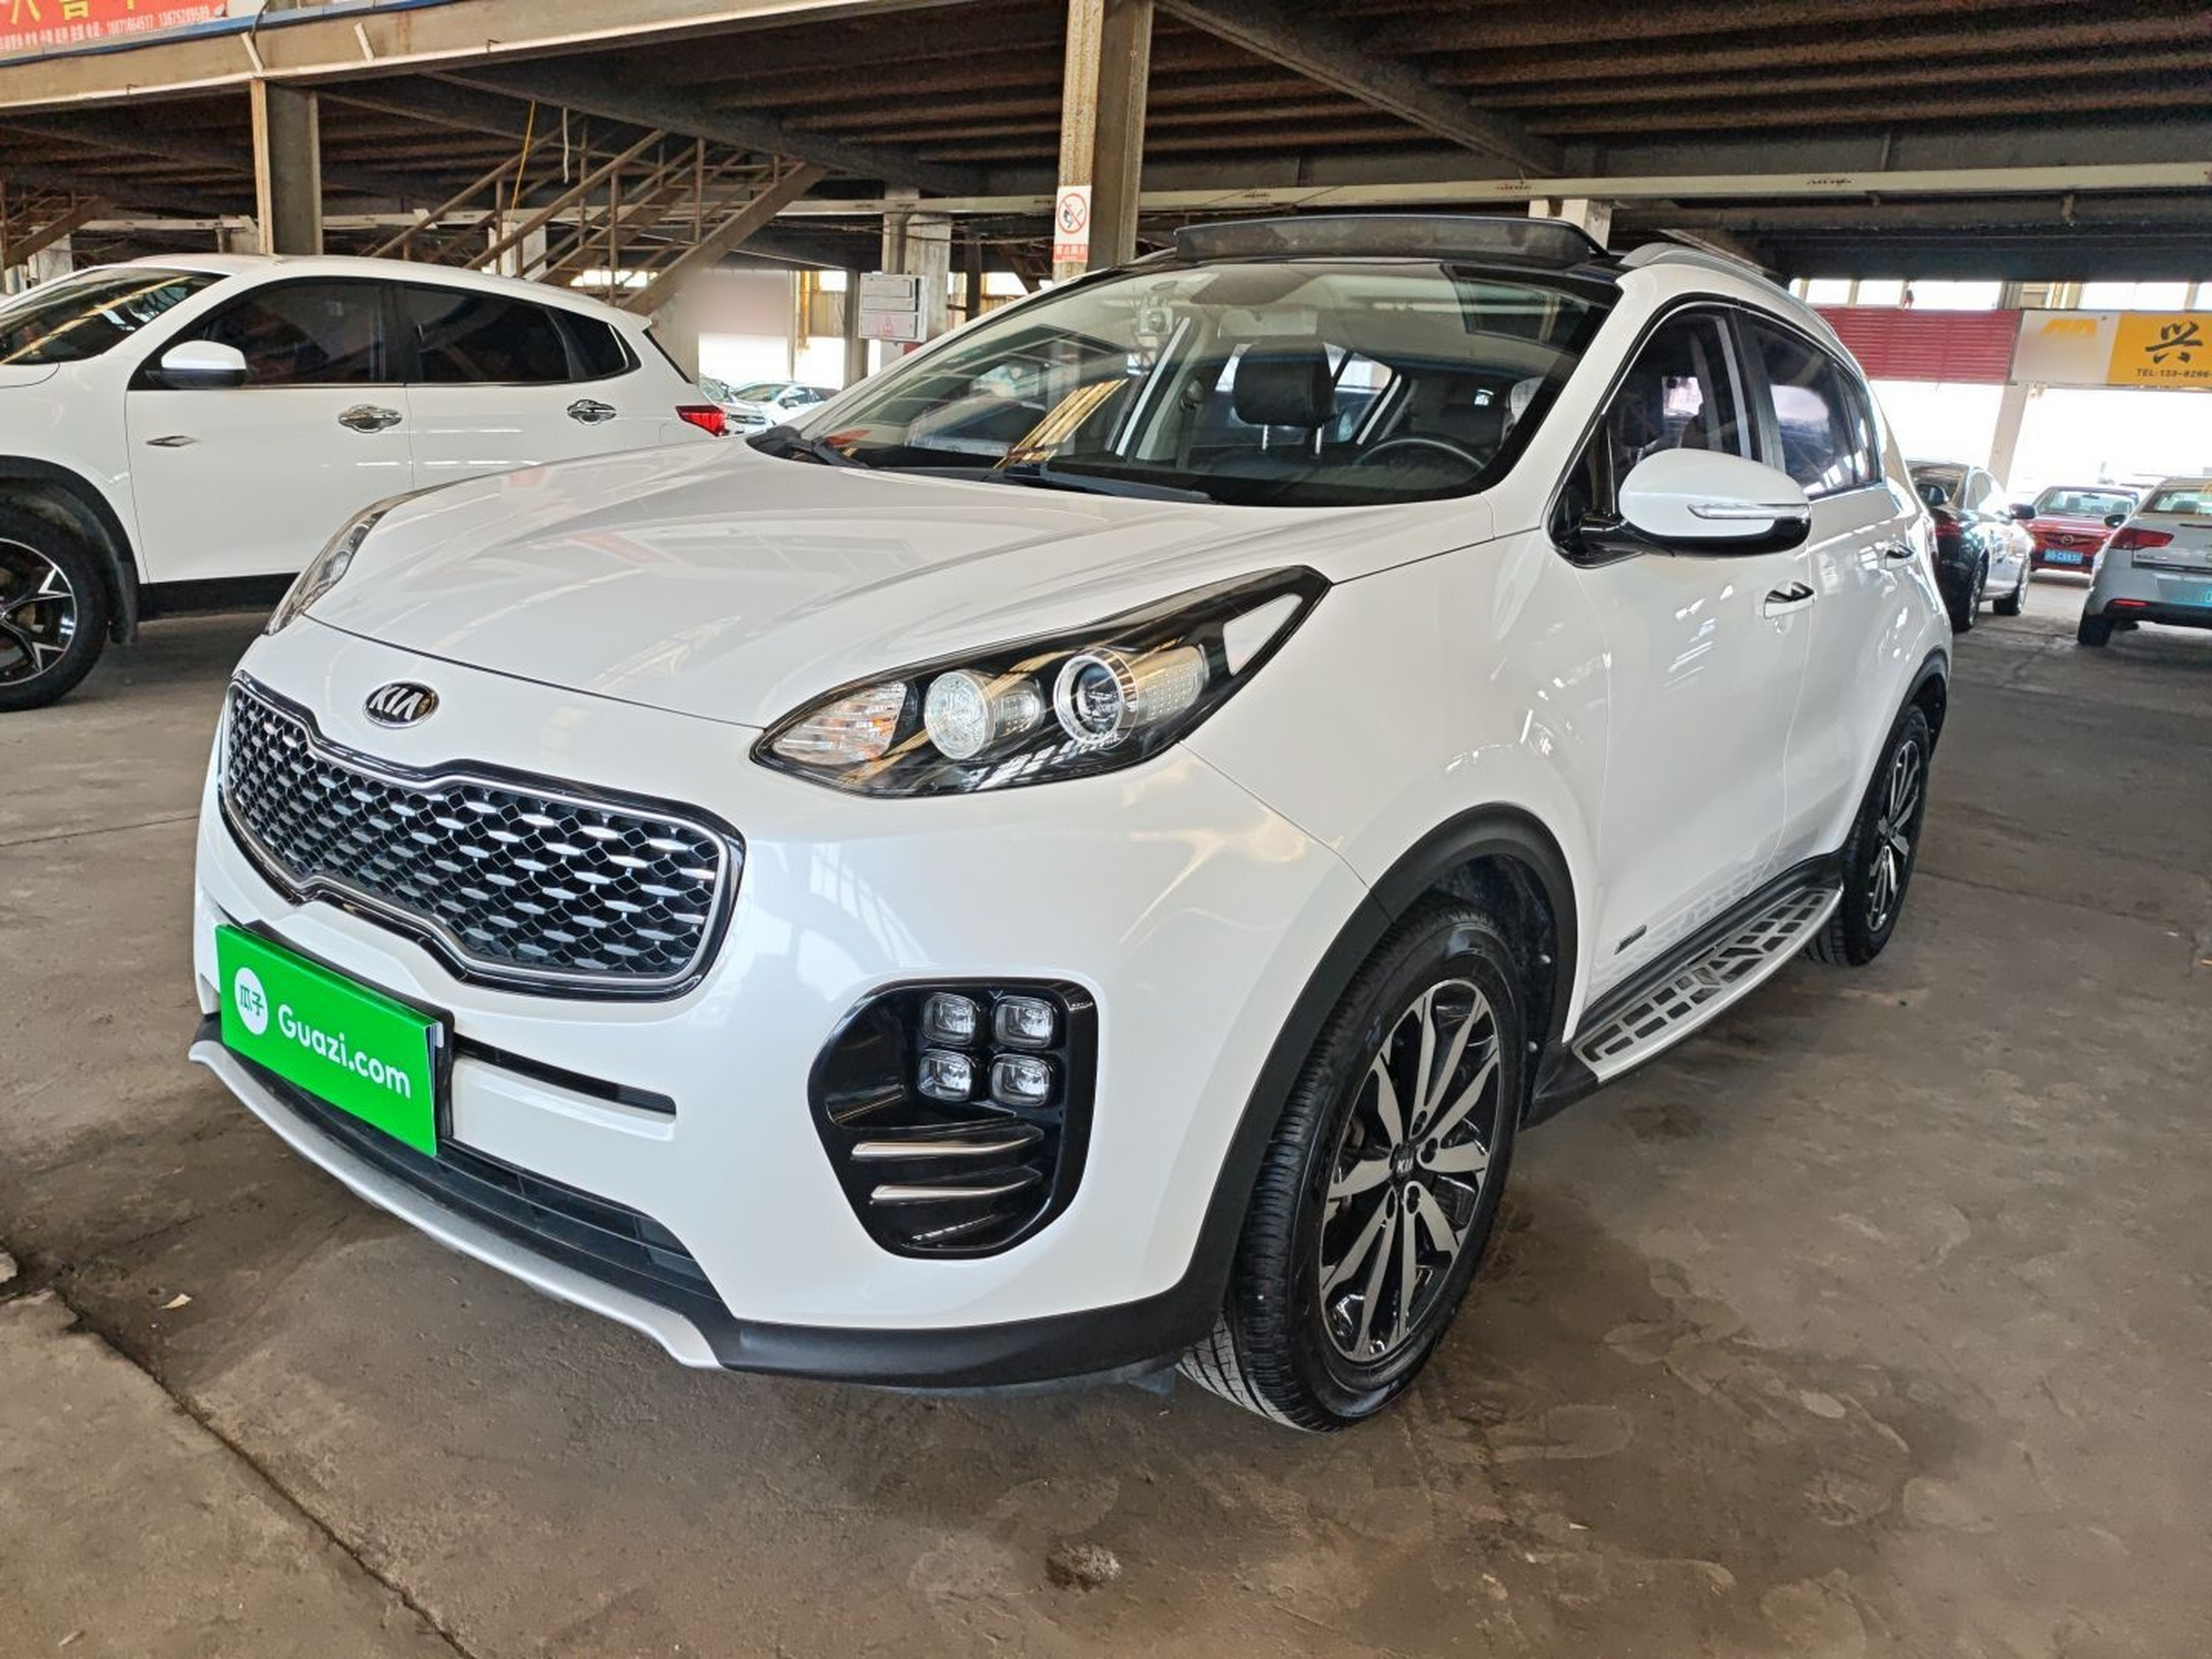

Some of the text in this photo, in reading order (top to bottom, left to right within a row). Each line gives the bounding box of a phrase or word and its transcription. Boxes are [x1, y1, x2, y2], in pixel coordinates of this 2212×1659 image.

[2145, 320, 2203, 363] 兴
[368, 685, 424, 721] KIA
[240, 984, 264, 1017] 瓜子
[277, 1003, 411, 1099] Guazi.com
